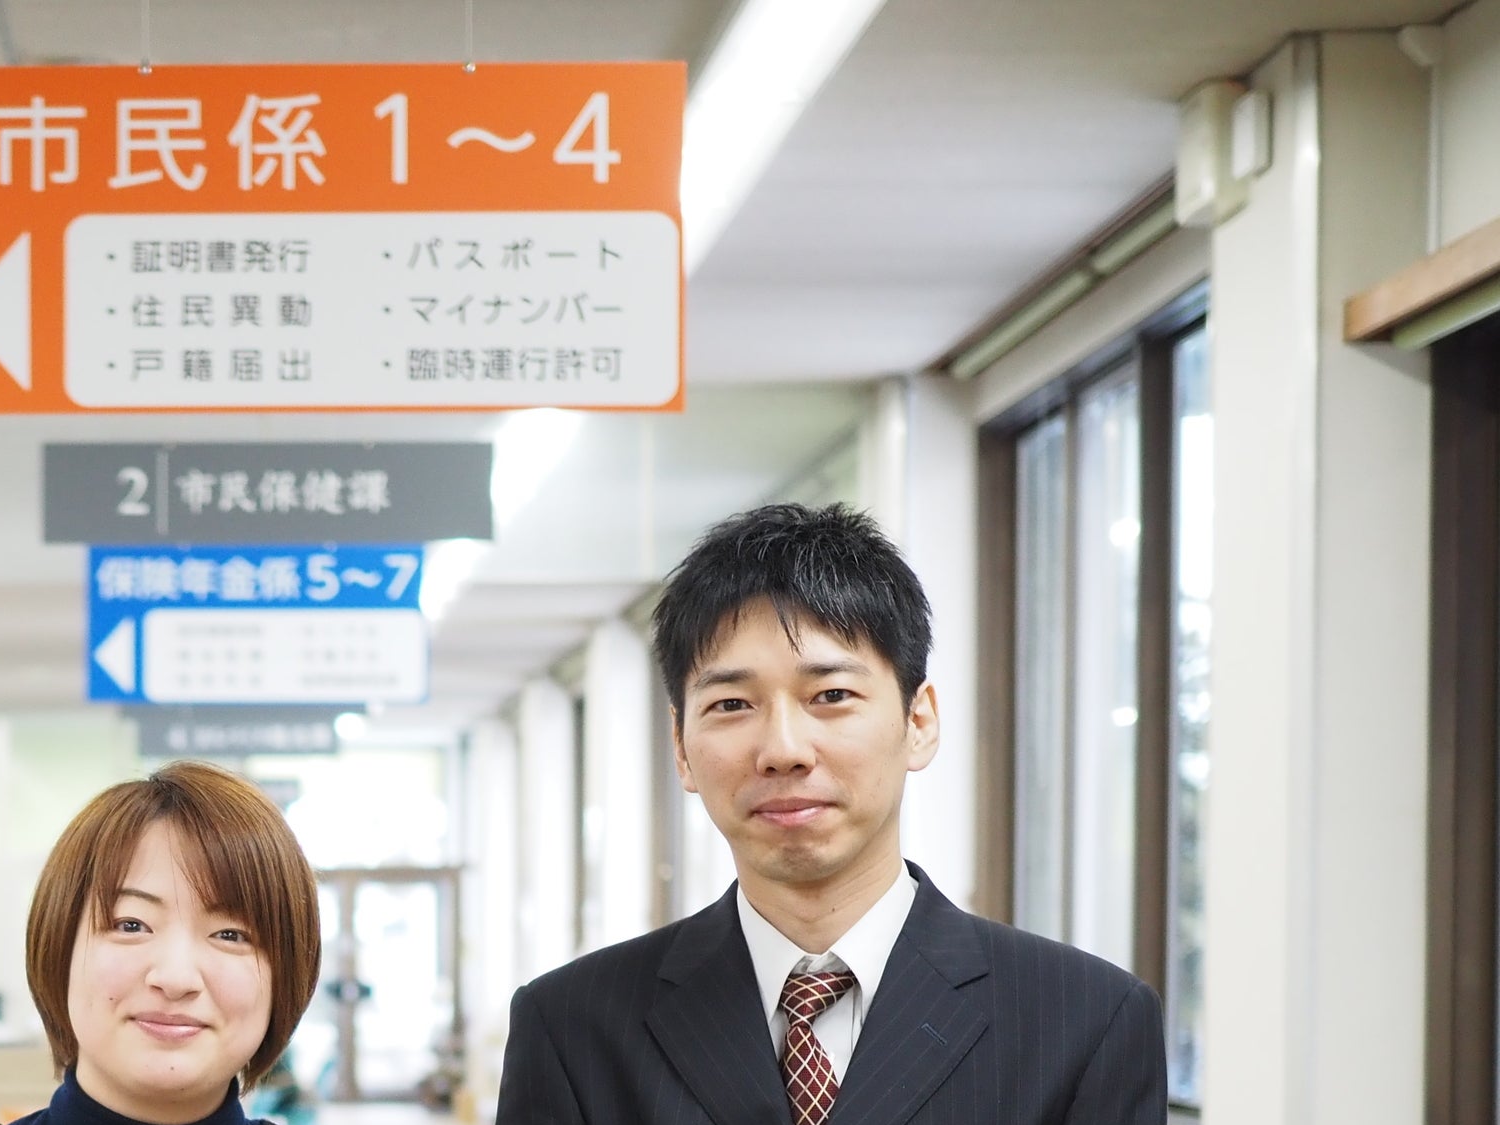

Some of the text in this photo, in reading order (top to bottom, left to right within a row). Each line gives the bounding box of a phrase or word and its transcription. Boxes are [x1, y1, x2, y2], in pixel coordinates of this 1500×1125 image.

[116, 467, 391, 516] 2 市民保健課
